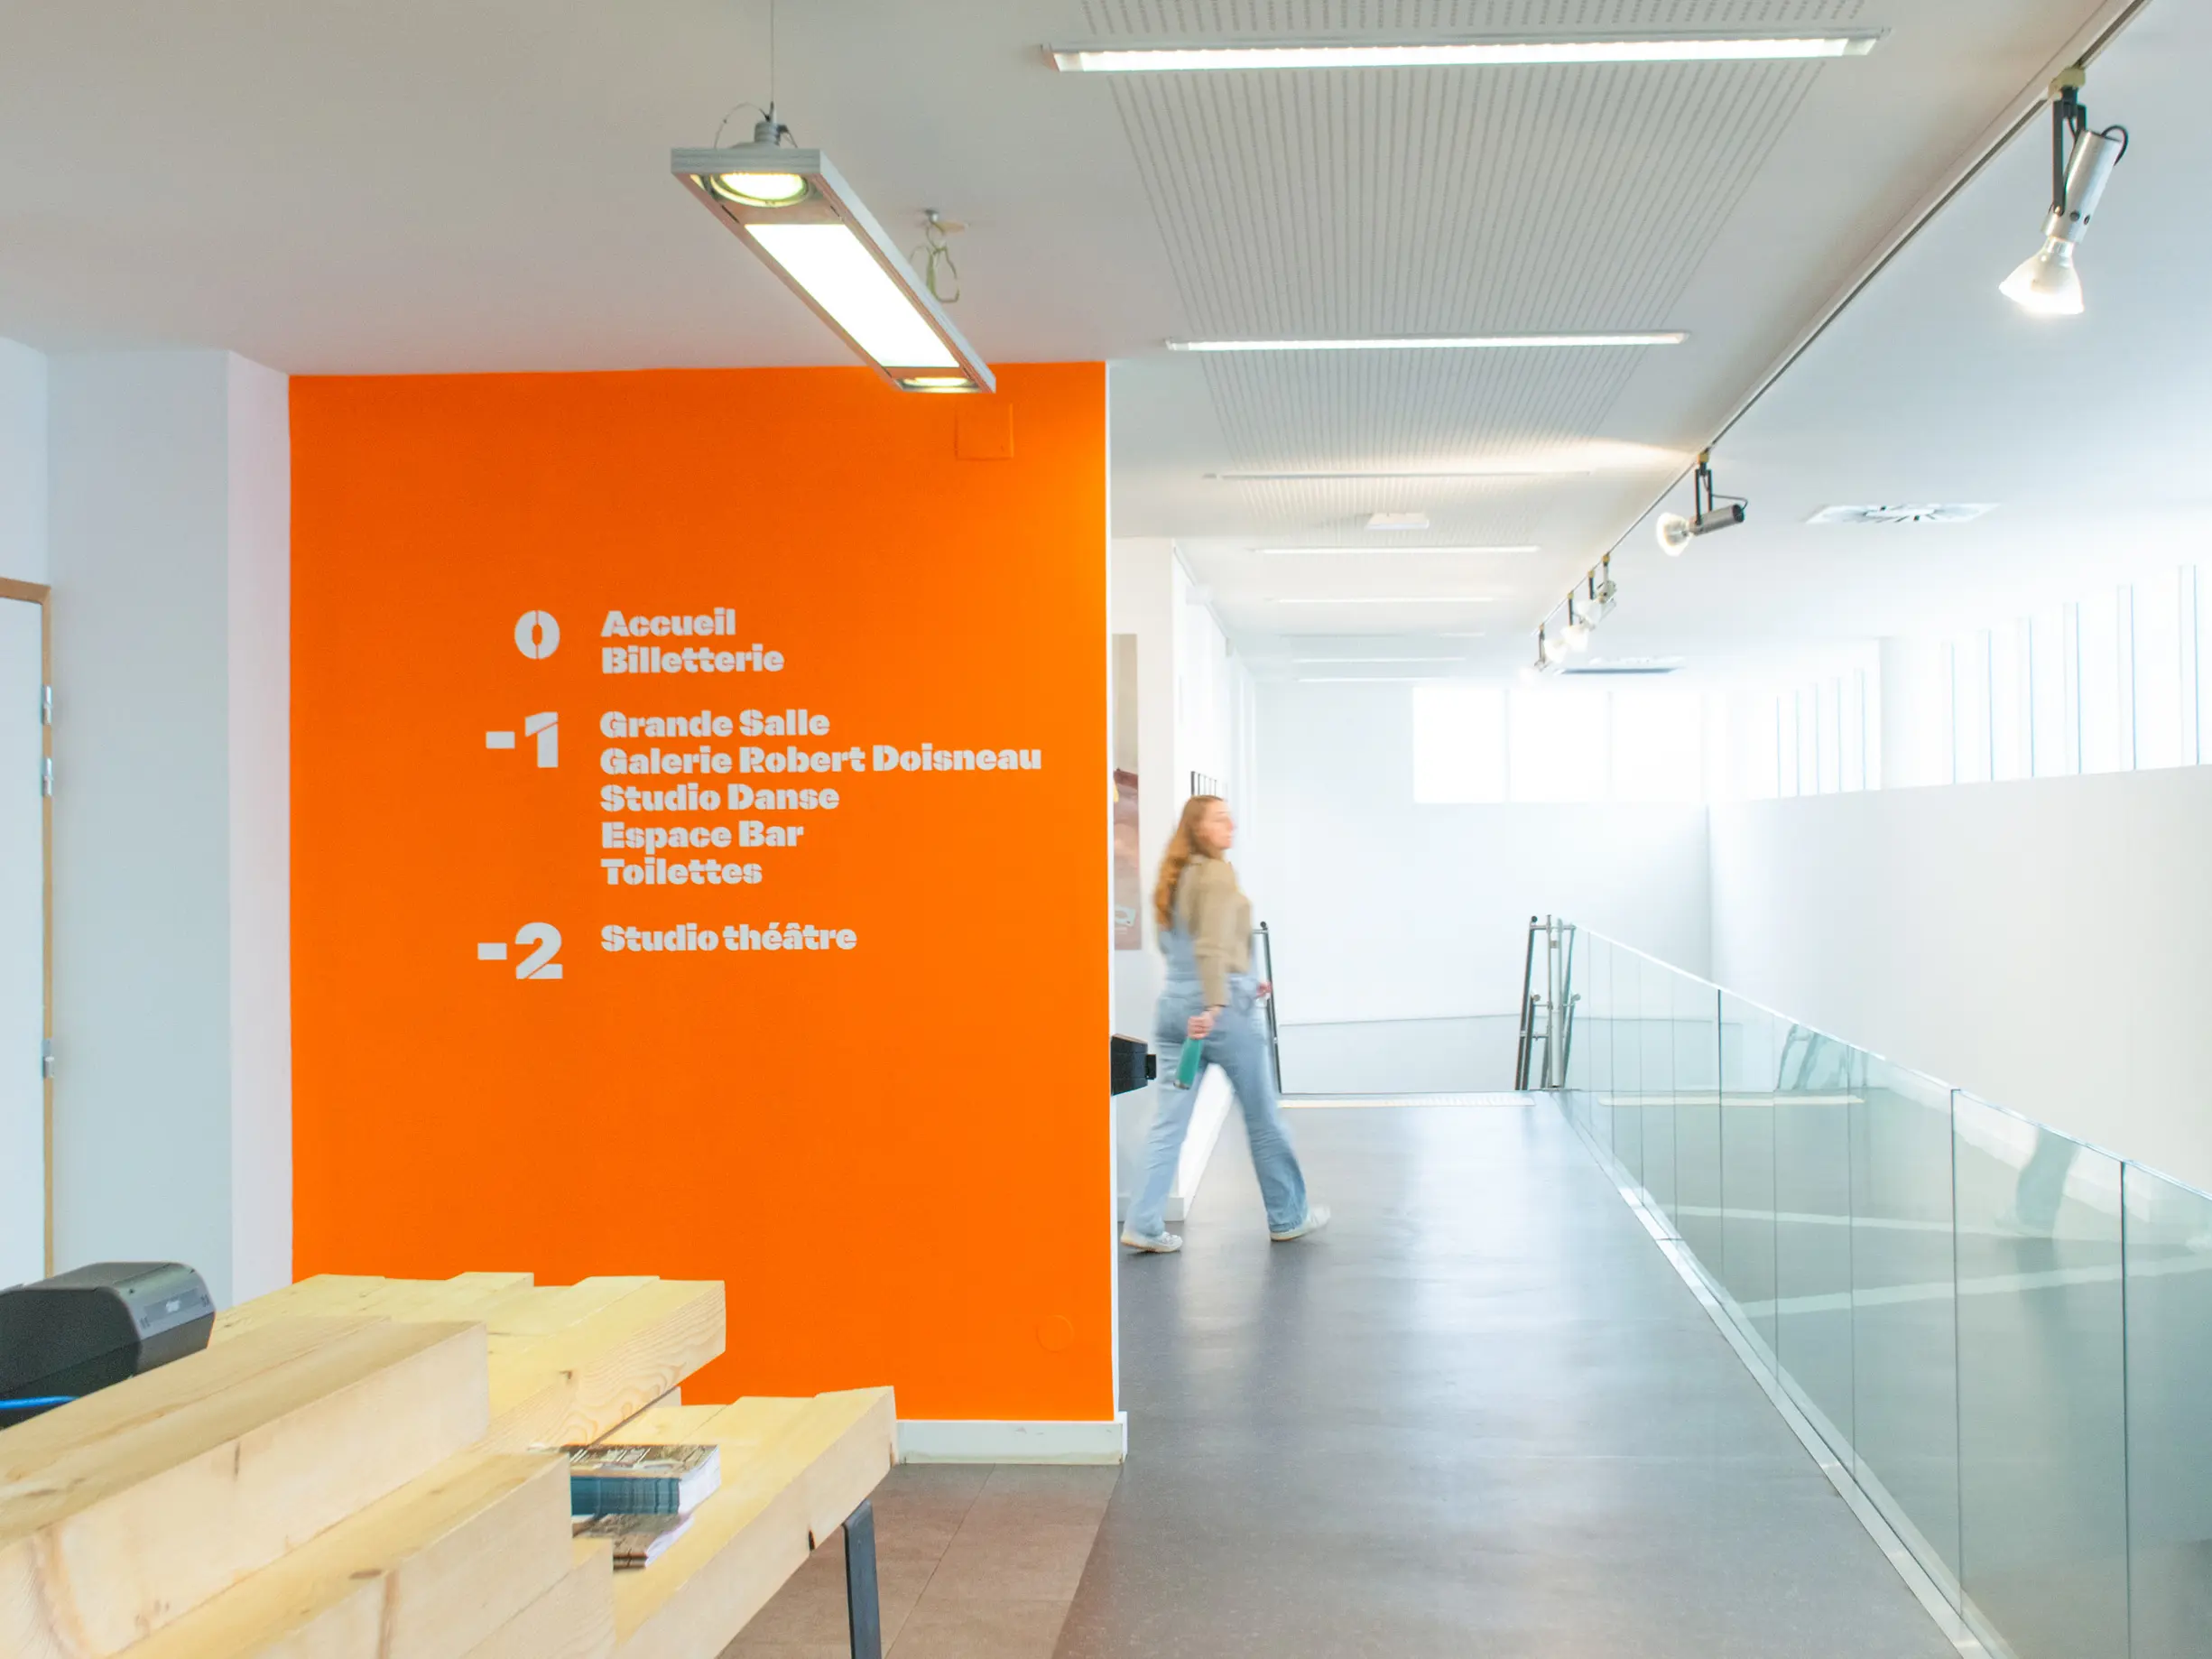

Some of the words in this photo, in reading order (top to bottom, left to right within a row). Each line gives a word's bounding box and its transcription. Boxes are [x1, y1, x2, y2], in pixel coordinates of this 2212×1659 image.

[515, 611, 560, 659] 0
[602, 607, 736, 636] Accueil
[603, 644, 783, 673] Billetterie
[600, 710, 733, 738] Grande
[740, 709, 829, 737] Salle
[486, 712, 558, 767] -1
[601, 746, 732, 774] Galerie
[740, 746, 865, 773] Robert
[874, 743, 1041, 771] Doisneau
[601, 783, 720, 811] Studio
[728, 783, 839, 810] Danse
[603, 822, 731, 855] Espace
[739, 820, 803, 847] Bar
[601, 857, 762, 885] Toilettes
[478, 922, 562, 978] -2
[602, 923, 718, 951] Studio
[723, 922, 856, 950] théâtre
